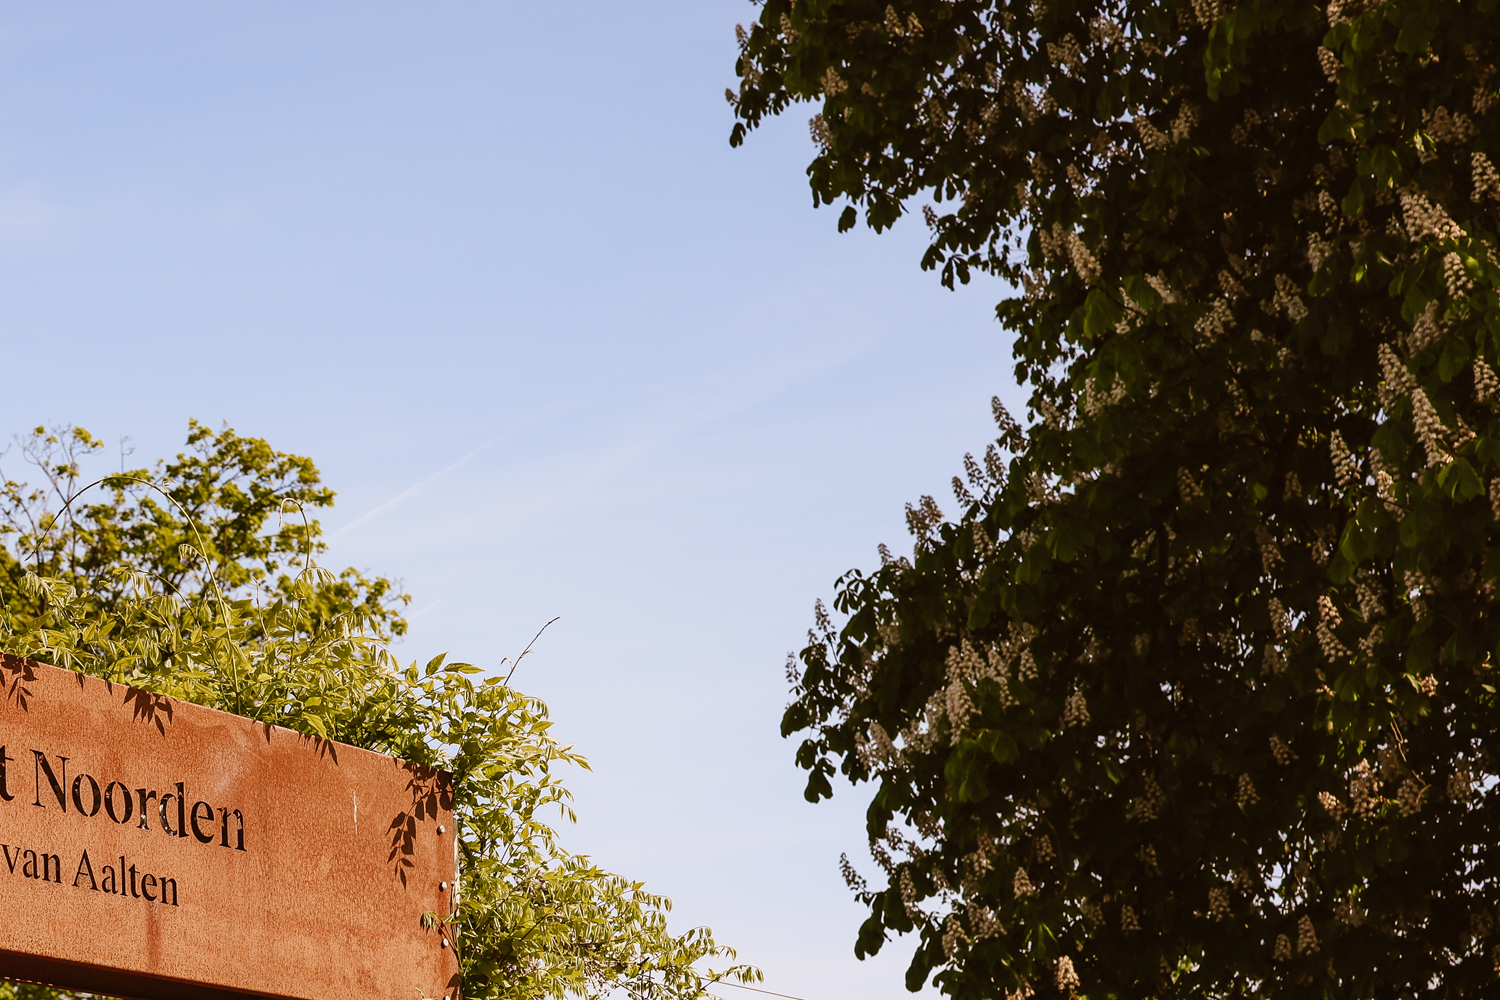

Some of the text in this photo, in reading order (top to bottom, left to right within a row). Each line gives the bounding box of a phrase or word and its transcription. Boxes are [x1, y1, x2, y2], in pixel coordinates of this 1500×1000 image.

[30, 749, 247, 851] Noorden
[0, 844, 179, 906] van Aalten
